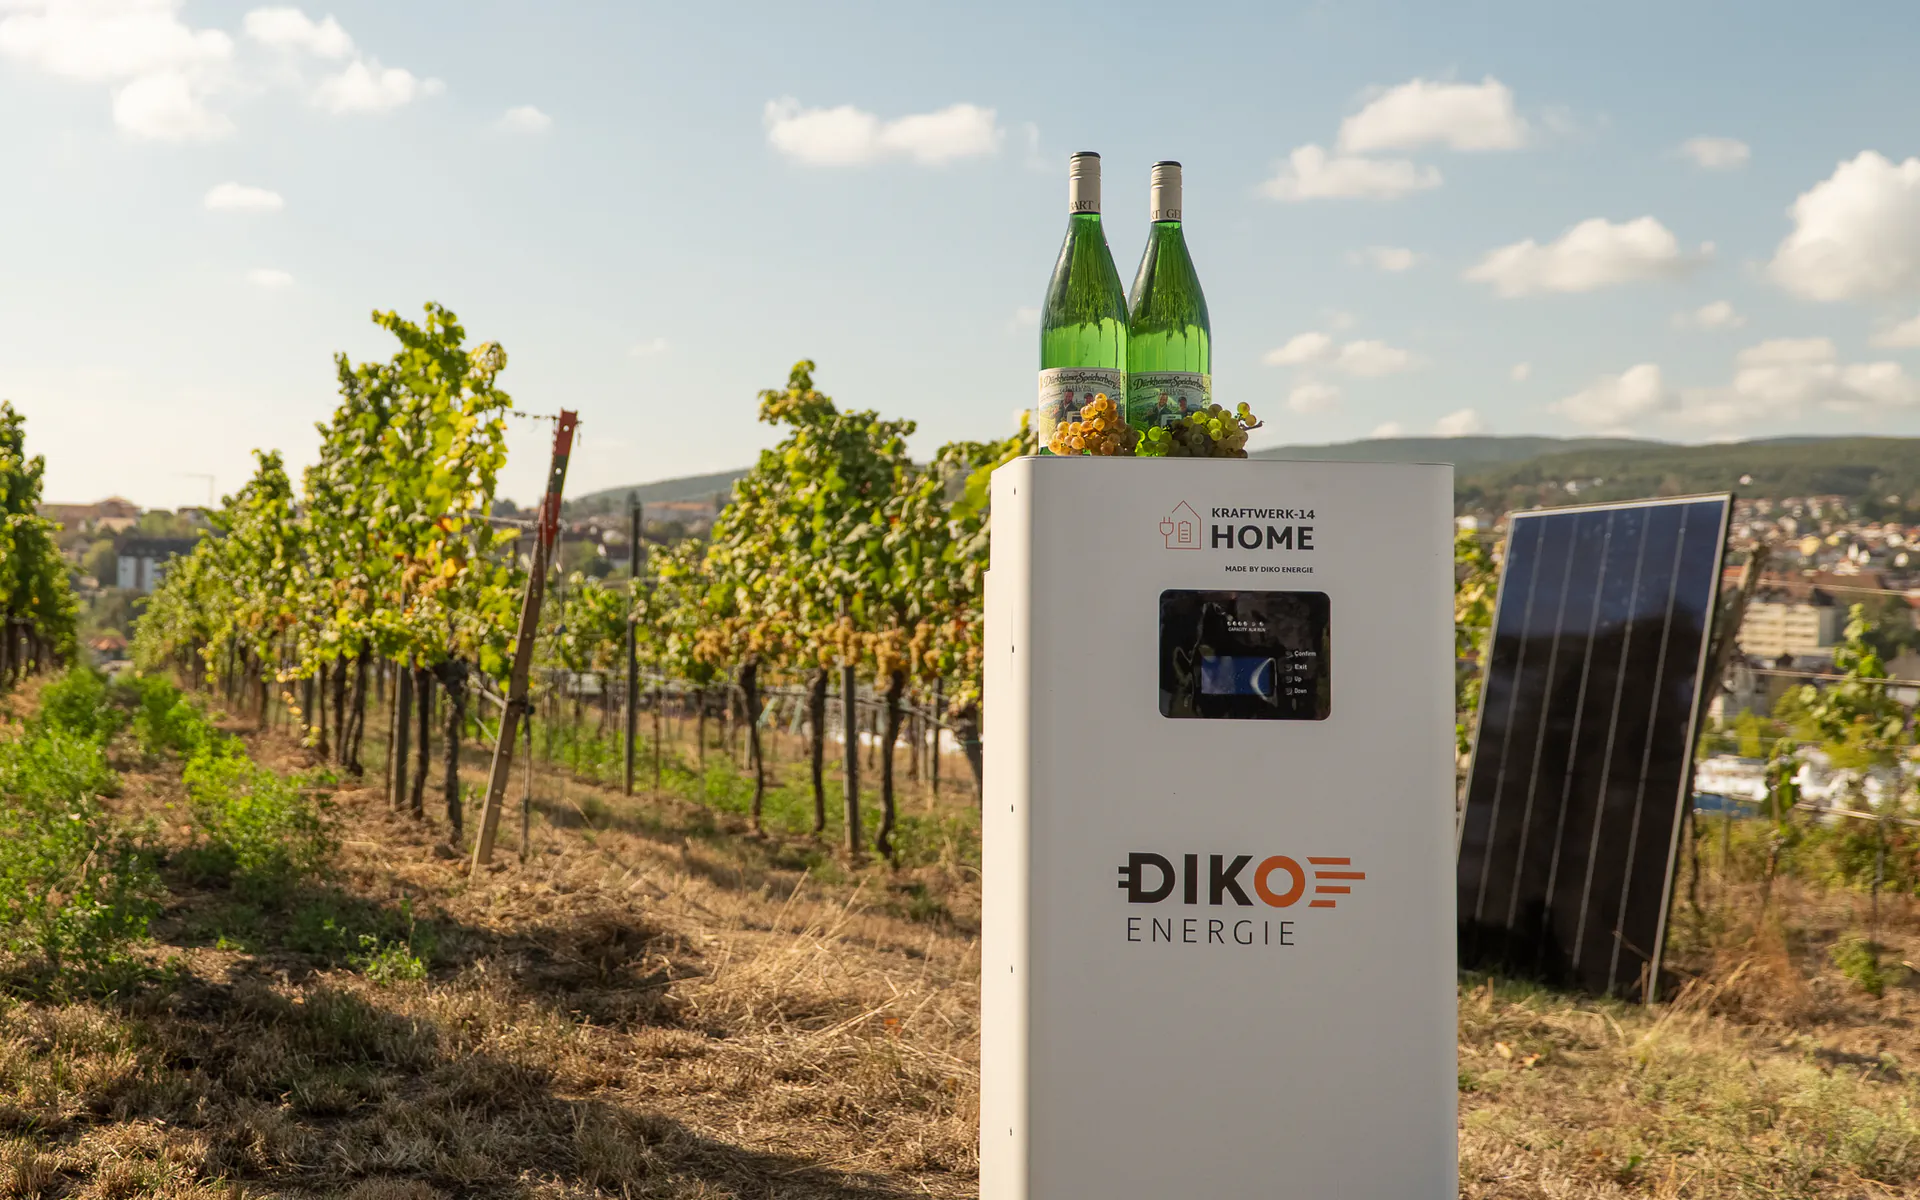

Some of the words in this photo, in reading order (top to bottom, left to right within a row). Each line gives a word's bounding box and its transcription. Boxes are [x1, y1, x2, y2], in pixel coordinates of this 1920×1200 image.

[1211, 507, 1316, 520] KRAFTWERK-14
[1211, 525, 1315, 550] HOME
[1225, 565, 1247, 573] MADE
[1281, 566, 1314, 574] ENERGIE
[1294, 675, 1302, 683] Up
[1118, 852, 1306, 908] DIKO
[1127, 917, 1295, 946] ENERGIE
